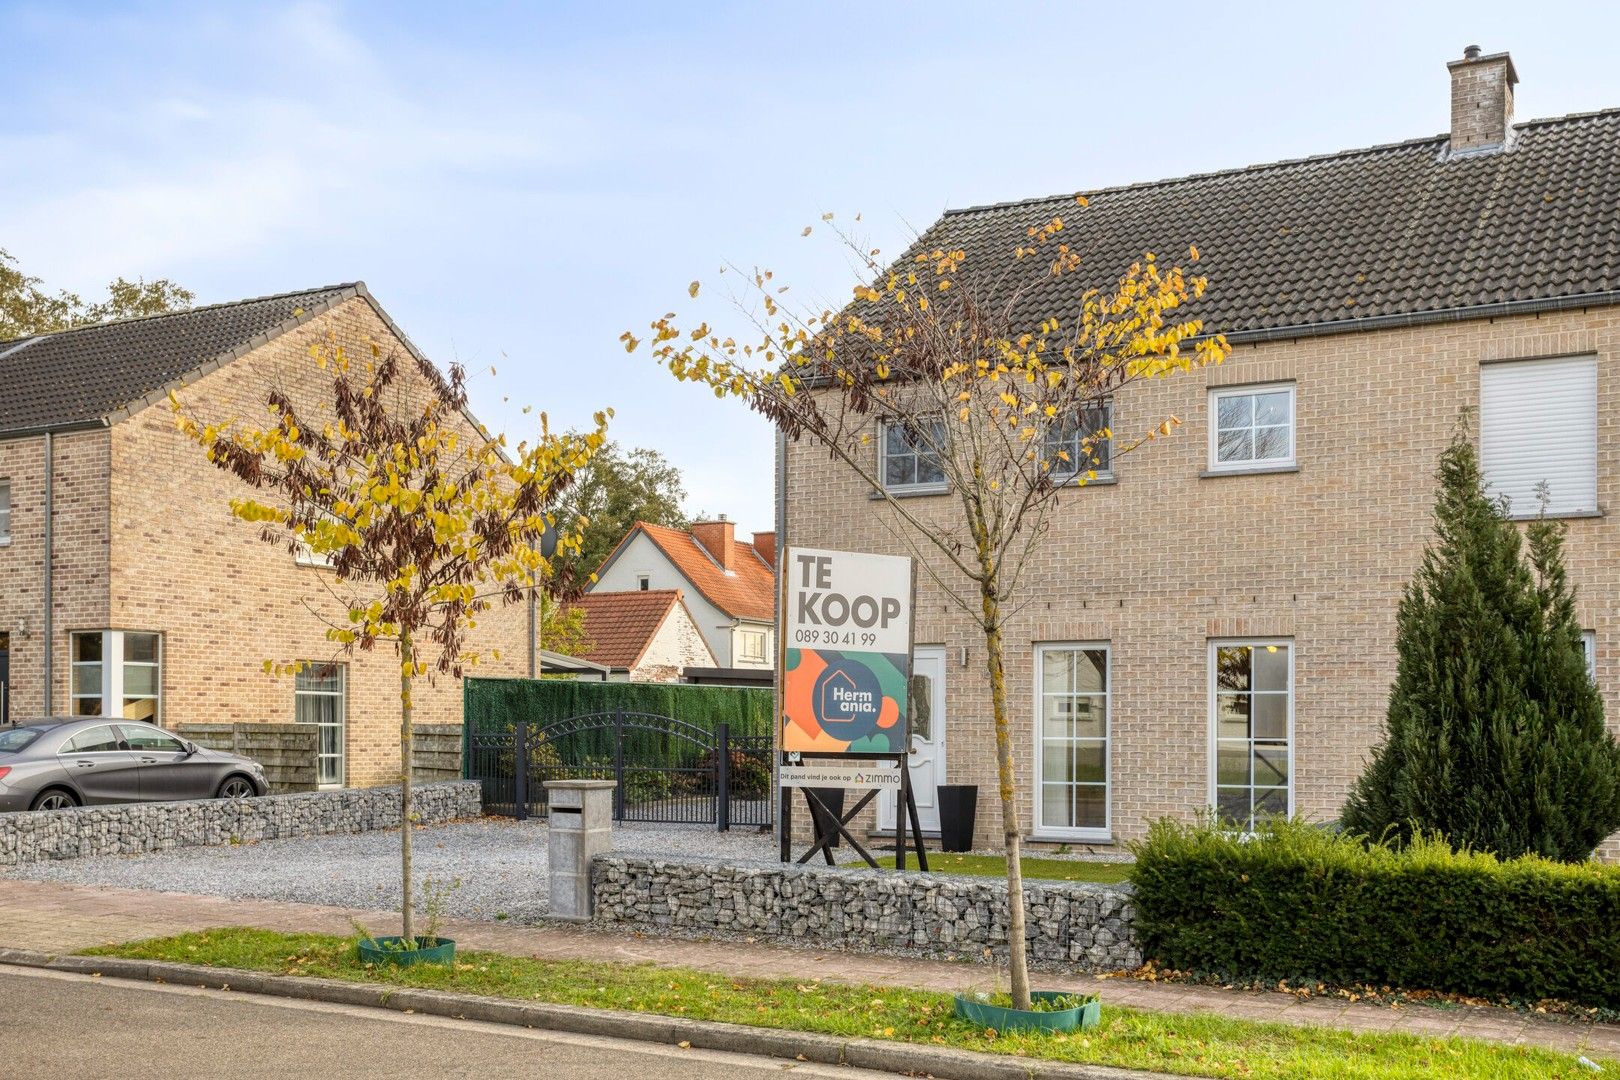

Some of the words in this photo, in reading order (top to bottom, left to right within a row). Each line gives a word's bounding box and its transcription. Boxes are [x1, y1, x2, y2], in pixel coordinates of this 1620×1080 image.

[797, 555, 832, 589] TE
[798, 592, 901, 629] KOOP
[795, 629, 820, 643] 089
[822, 631, 839, 644] 30
[841, 632, 856, 645] 41
[861, 633, 876, 646] 99
[833, 687, 872, 702] Herm
